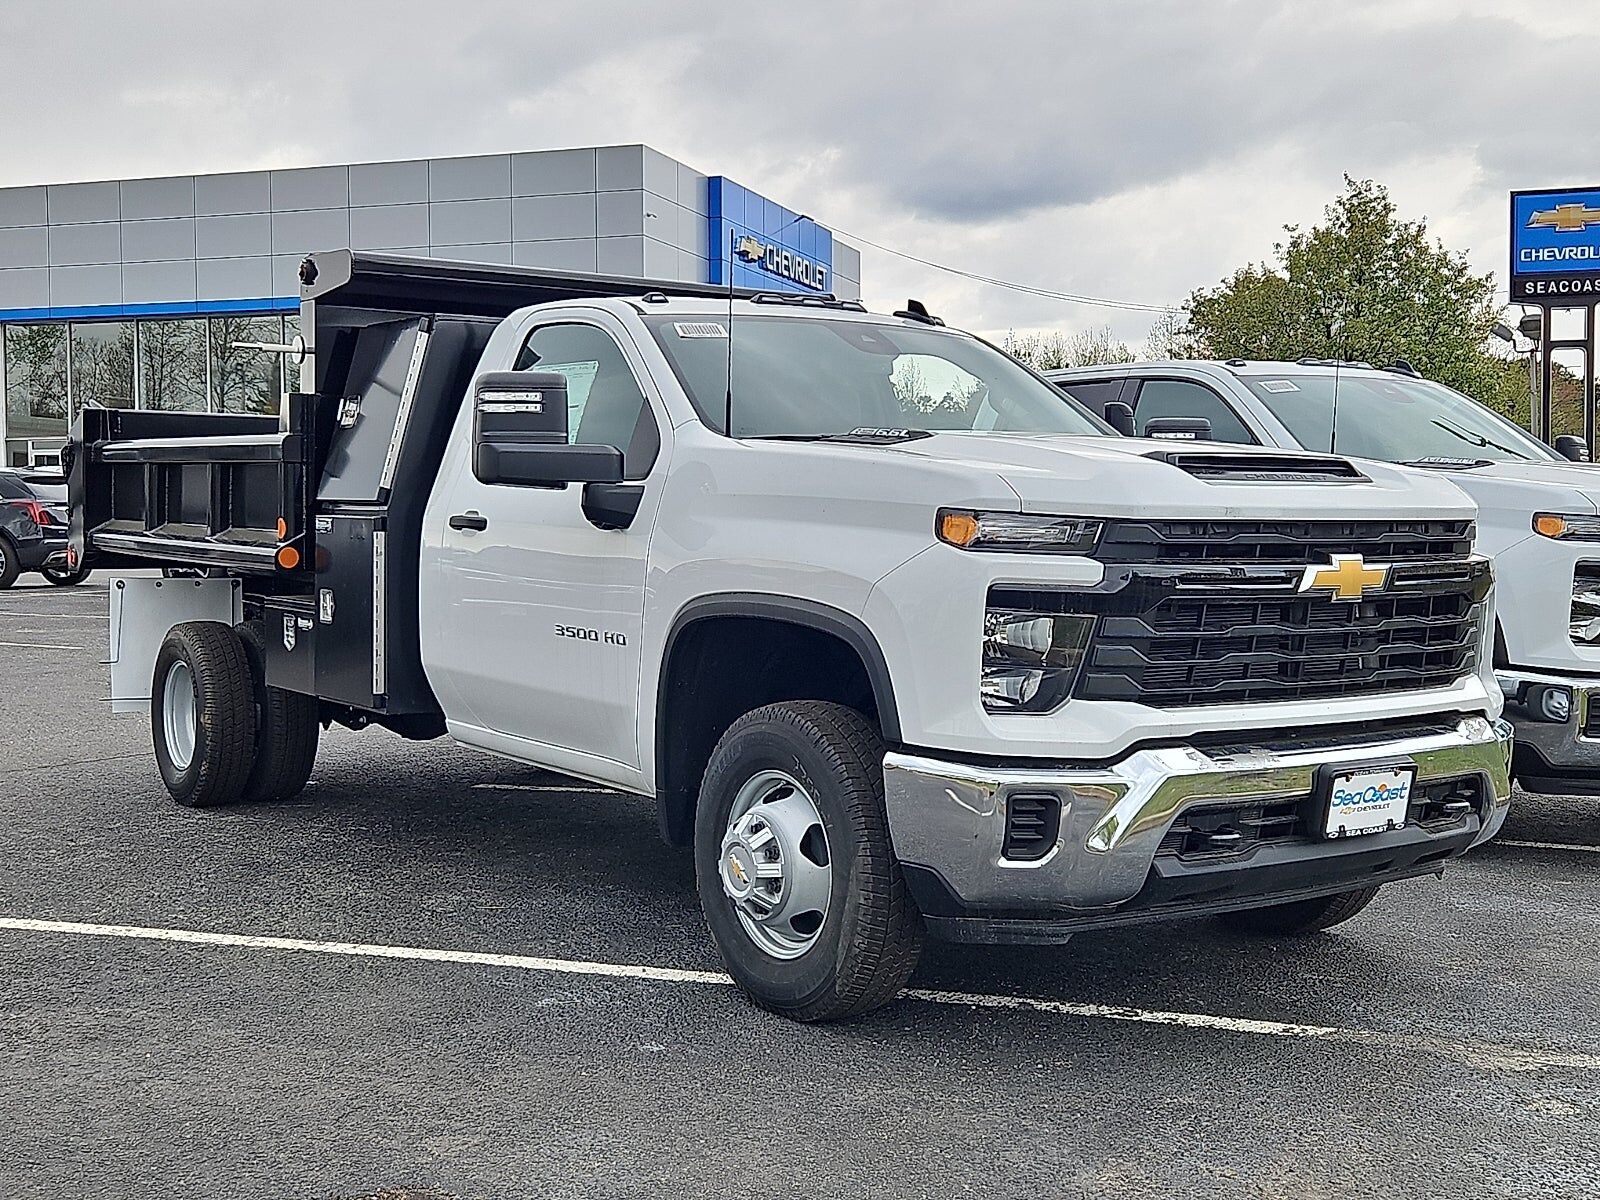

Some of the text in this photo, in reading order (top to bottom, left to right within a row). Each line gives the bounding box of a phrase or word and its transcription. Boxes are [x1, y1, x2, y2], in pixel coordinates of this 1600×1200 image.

[1520, 246, 1600, 261] CHEVROL
[765, 244, 828, 290] CHEVROLET
[1243, 473, 1328, 481] CHEVROLET
[555, 624, 627, 646] 3500 HD
[1346, 825, 1388, 837] SEA COAST
